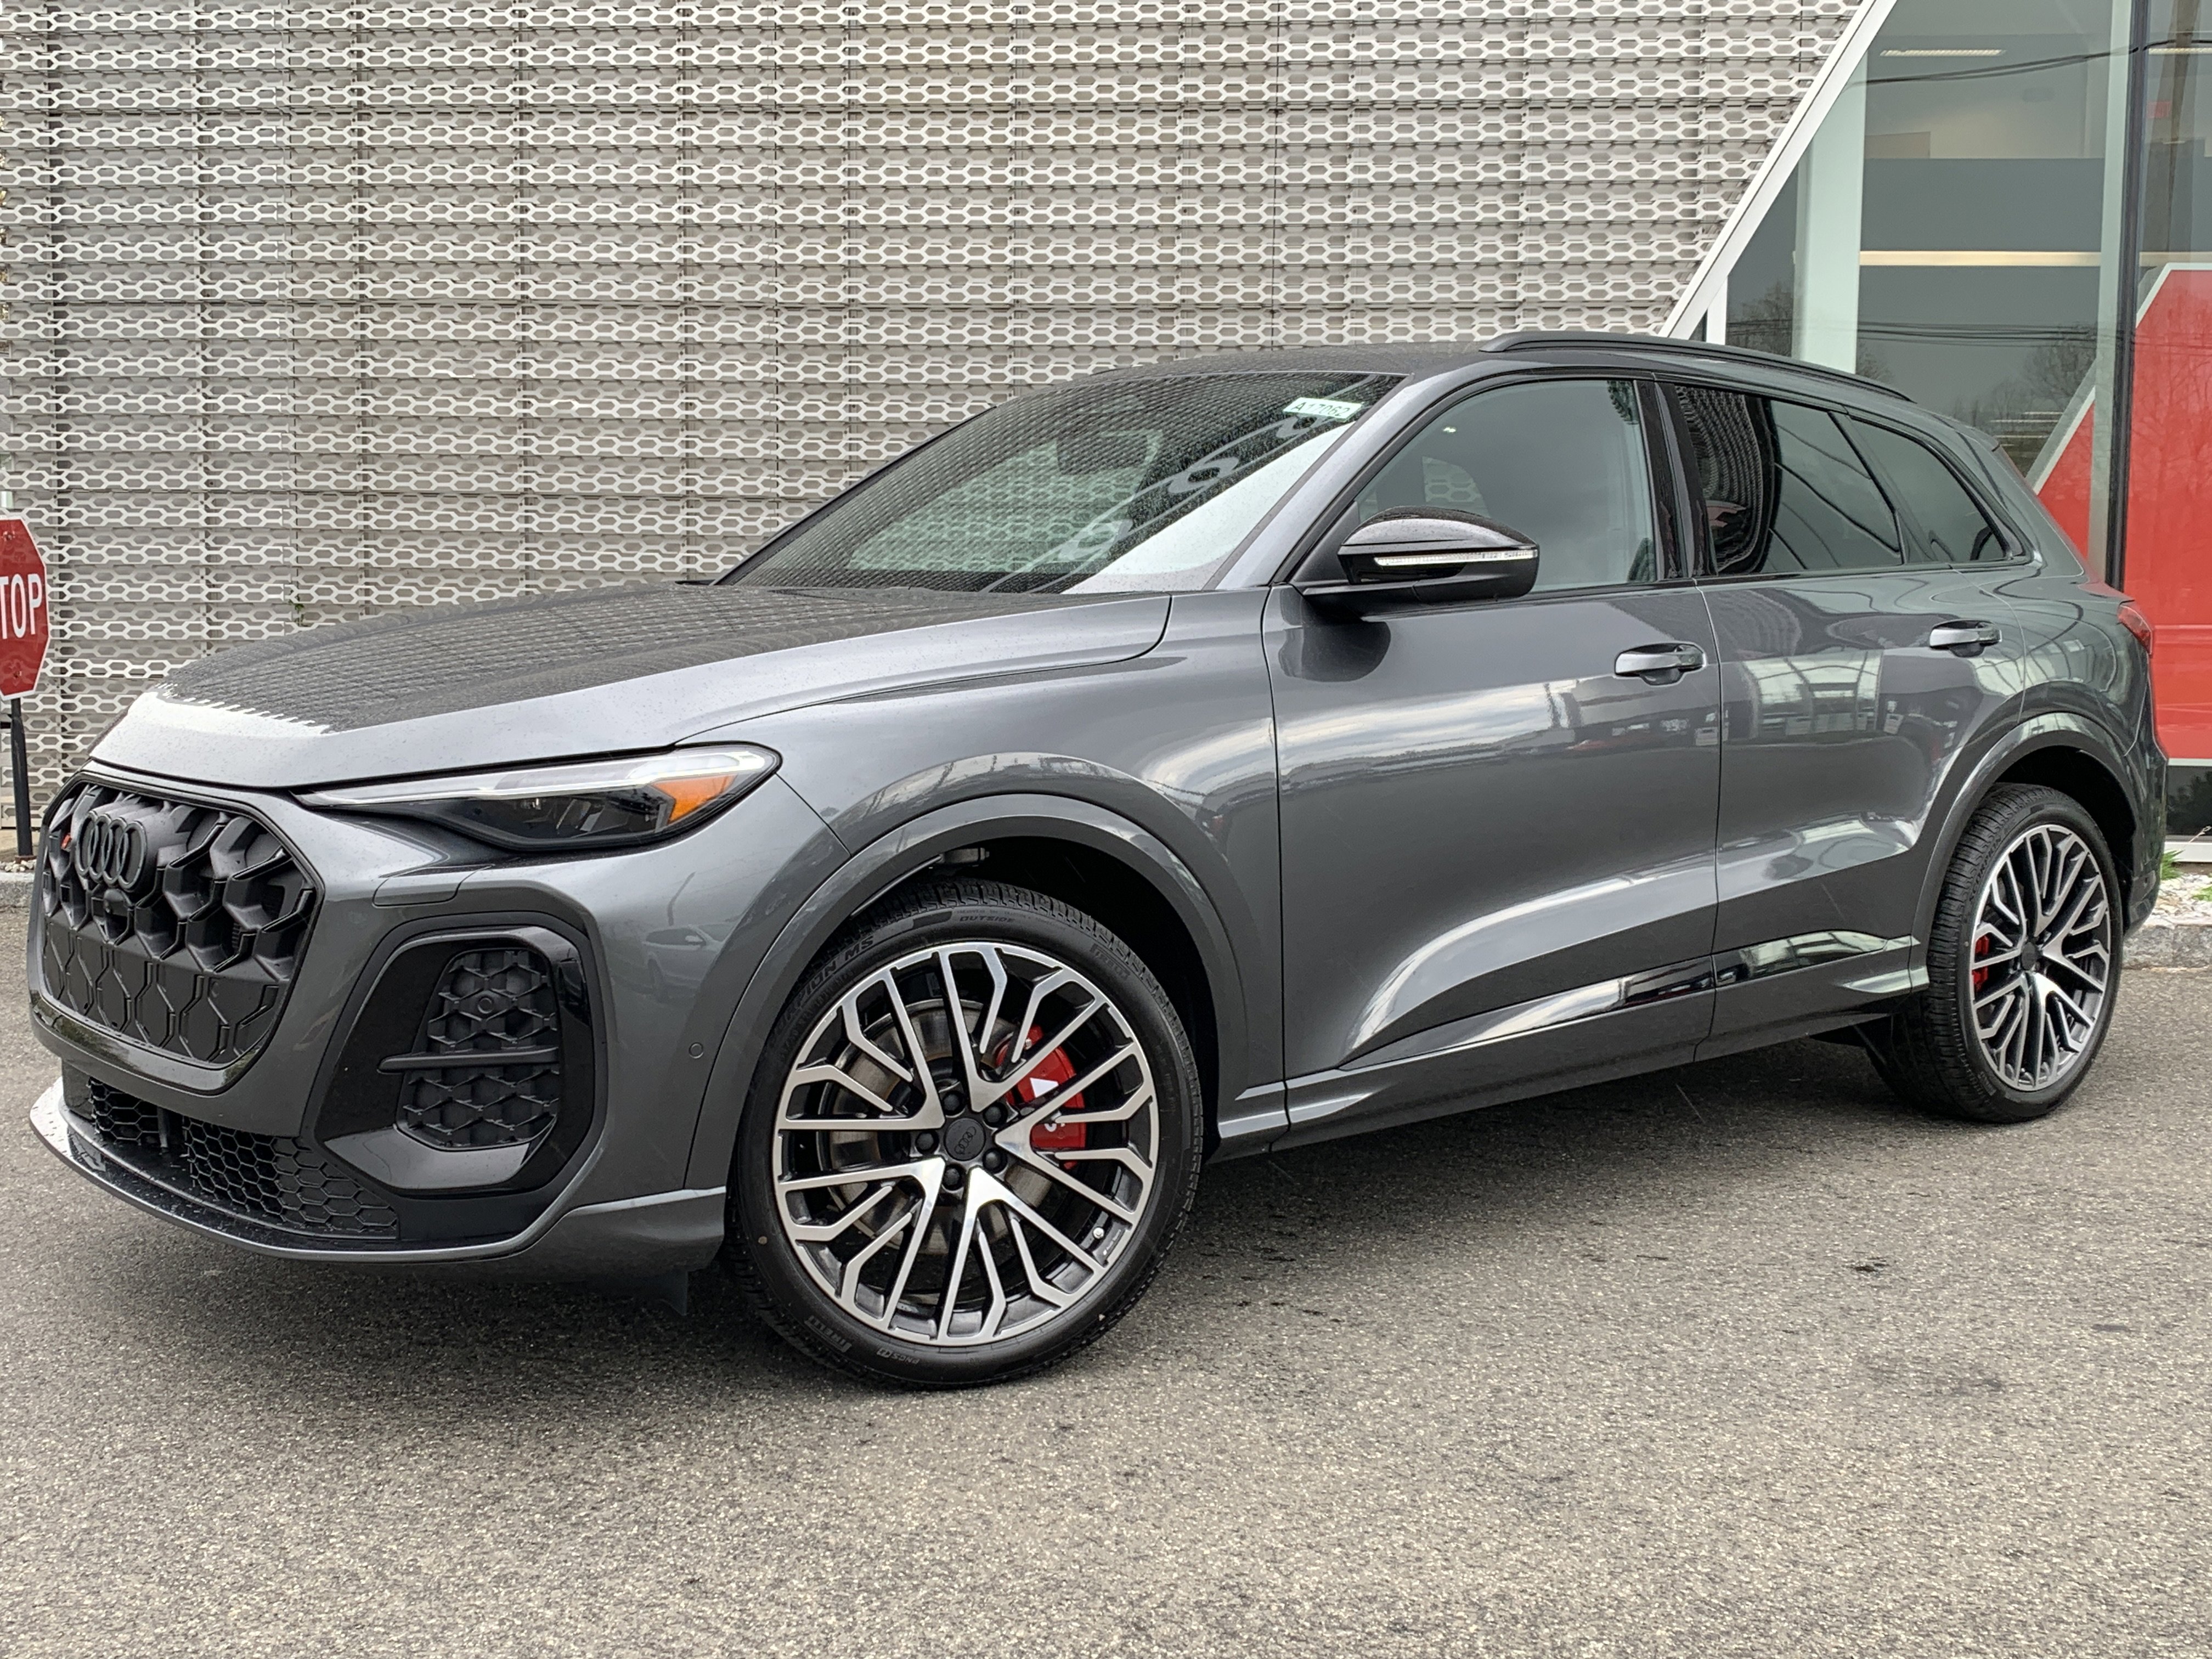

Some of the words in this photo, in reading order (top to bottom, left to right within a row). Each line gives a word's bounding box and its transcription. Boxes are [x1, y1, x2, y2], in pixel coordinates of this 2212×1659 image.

[1291, 402, 1350, 416] A17062
[0, 573, 42, 640] TOP
[845, 935, 873, 961] MS
[804, 1316, 851, 1352] PIRELLI
